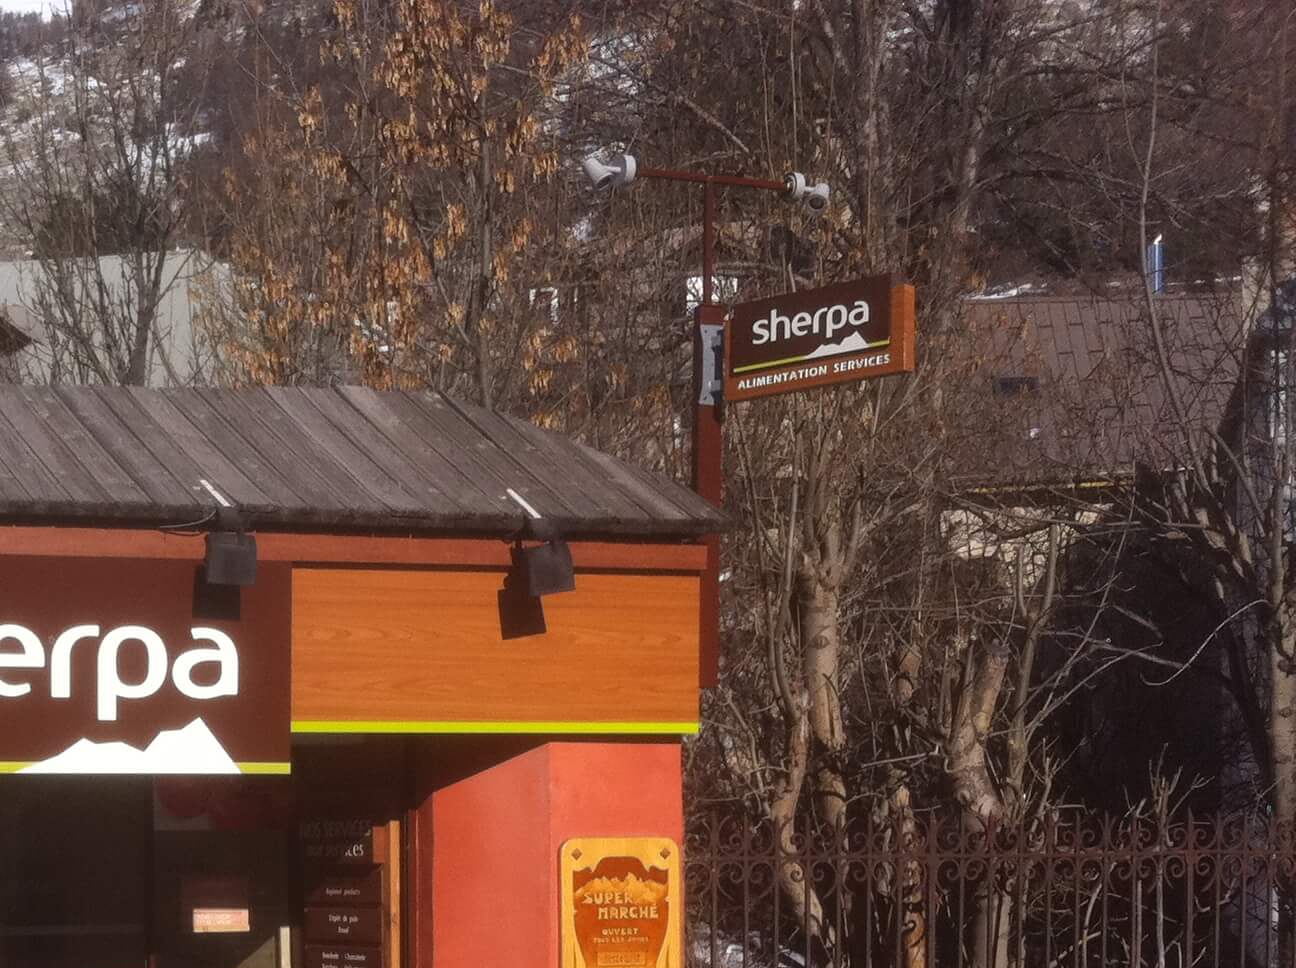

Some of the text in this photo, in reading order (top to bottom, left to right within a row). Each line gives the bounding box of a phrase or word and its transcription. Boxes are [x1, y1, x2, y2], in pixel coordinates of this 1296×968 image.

[752, 301, 870, 345] sherpa
[737, 354, 891, 389] ALIMENTATION SERVICES
[582, 892, 633, 905] SUPER
[601, 927, 640, 936] OUVERT
